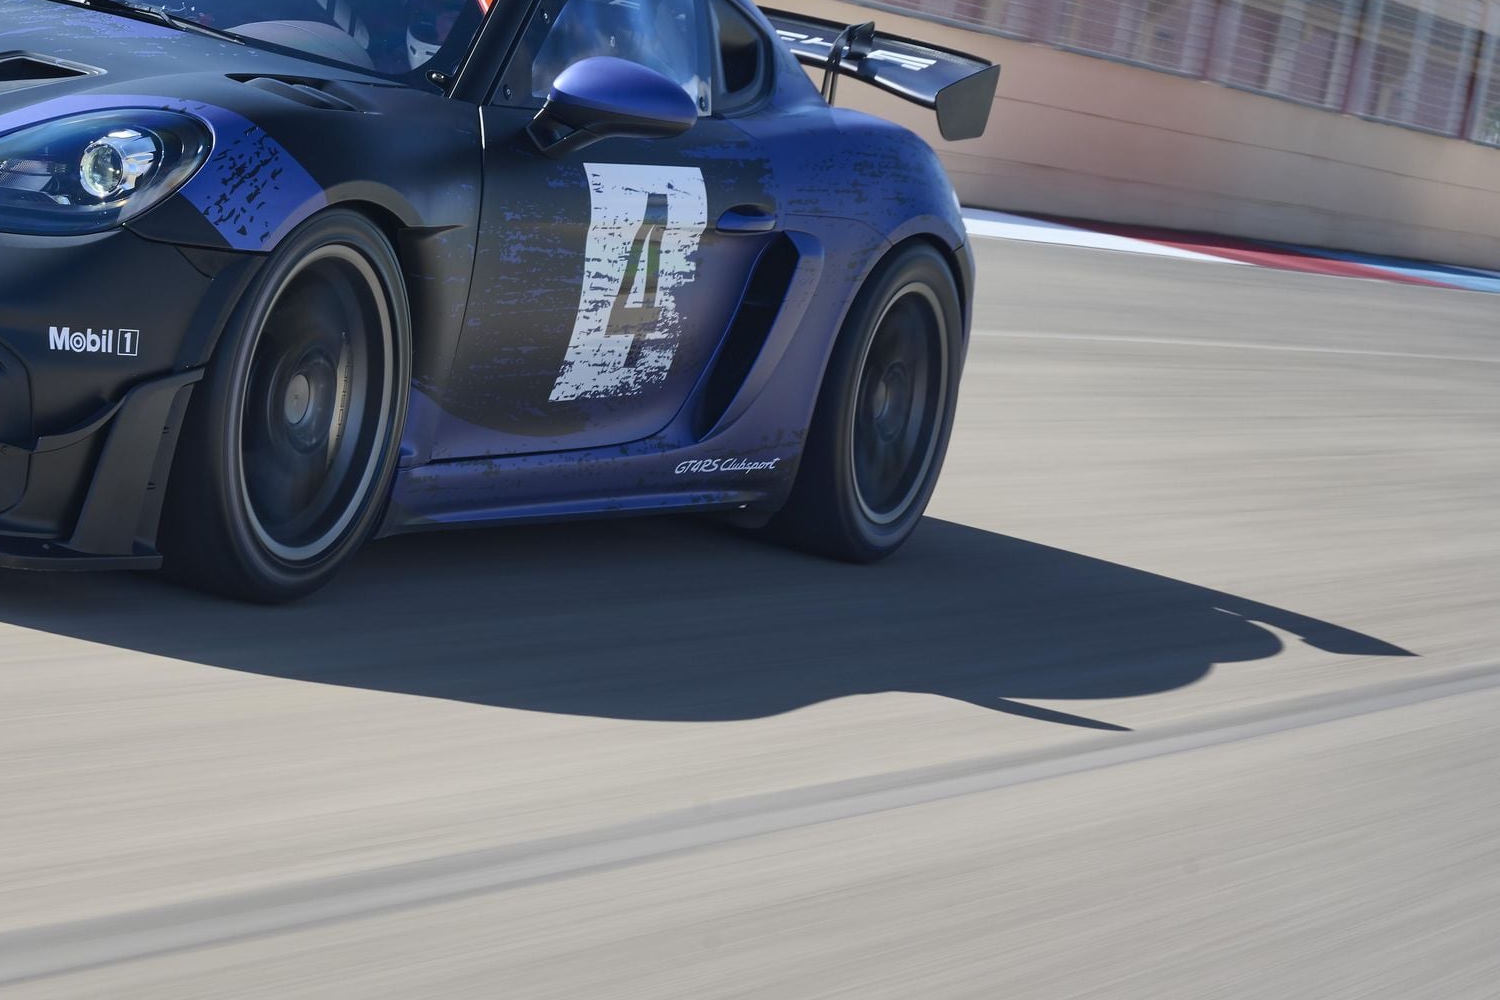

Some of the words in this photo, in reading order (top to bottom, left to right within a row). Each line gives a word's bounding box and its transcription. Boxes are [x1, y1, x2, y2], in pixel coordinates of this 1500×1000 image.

[603, 193, 673, 368] 4
[49, 326, 113, 353] Mobil
[720, 457, 780, 474] Clubsport
